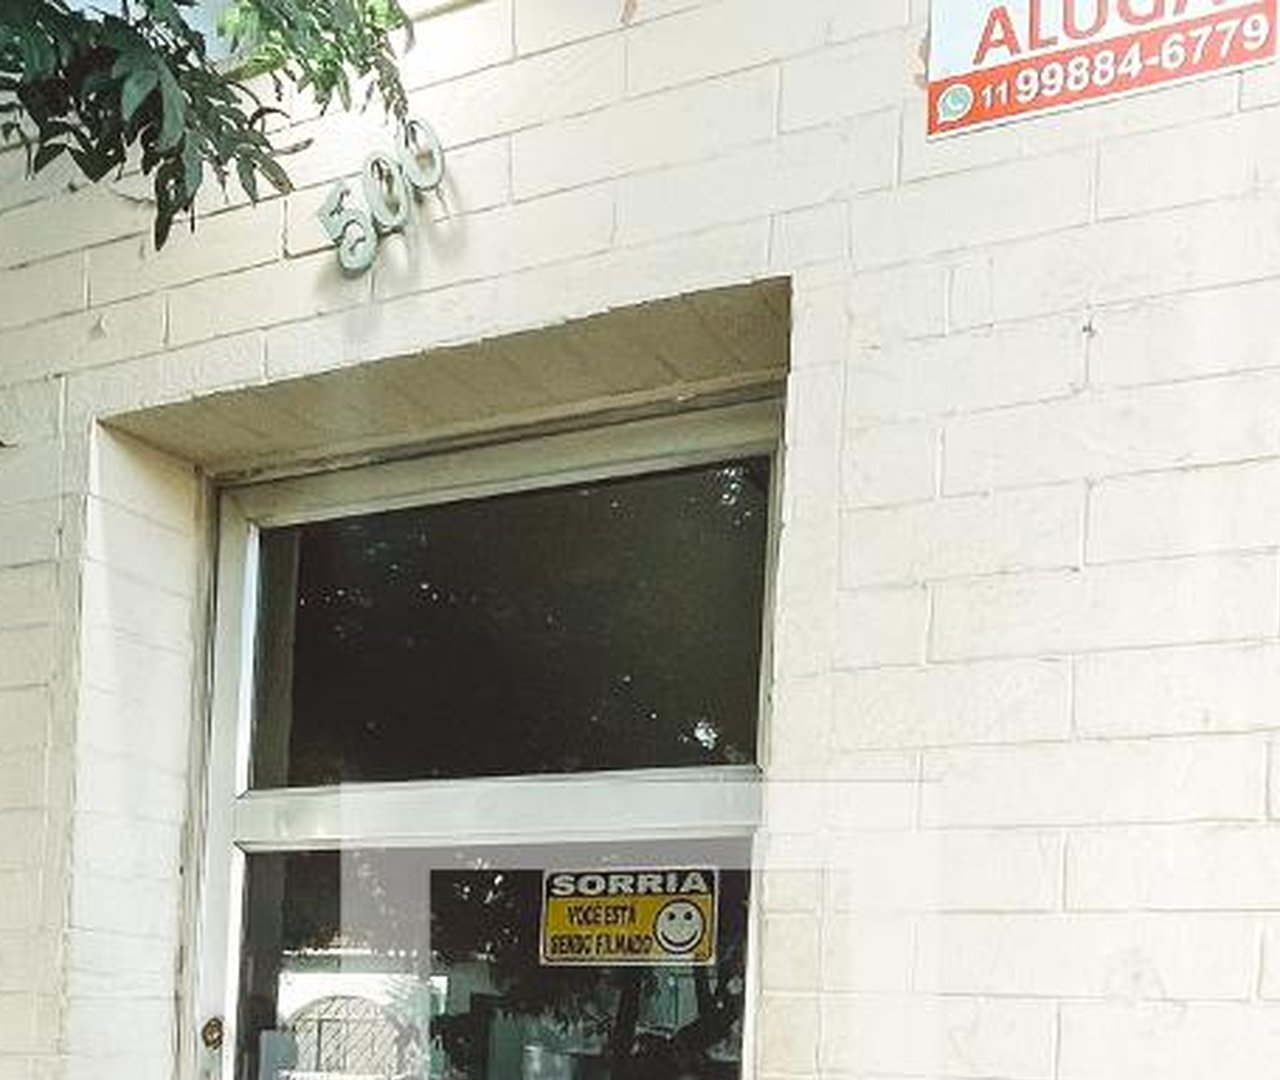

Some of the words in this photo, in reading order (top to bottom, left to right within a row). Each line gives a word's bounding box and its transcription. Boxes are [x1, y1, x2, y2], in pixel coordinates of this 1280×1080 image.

[971, 0, 1226, 64] ALUG
[982, 80, 1009, 110] 11
[1016, 13, 1269, 102] 99884-6779
[319, 118, 444, 278] 500
[552, 872, 708, 896] SORRIA
[550, 935, 591, 956] SENDO
